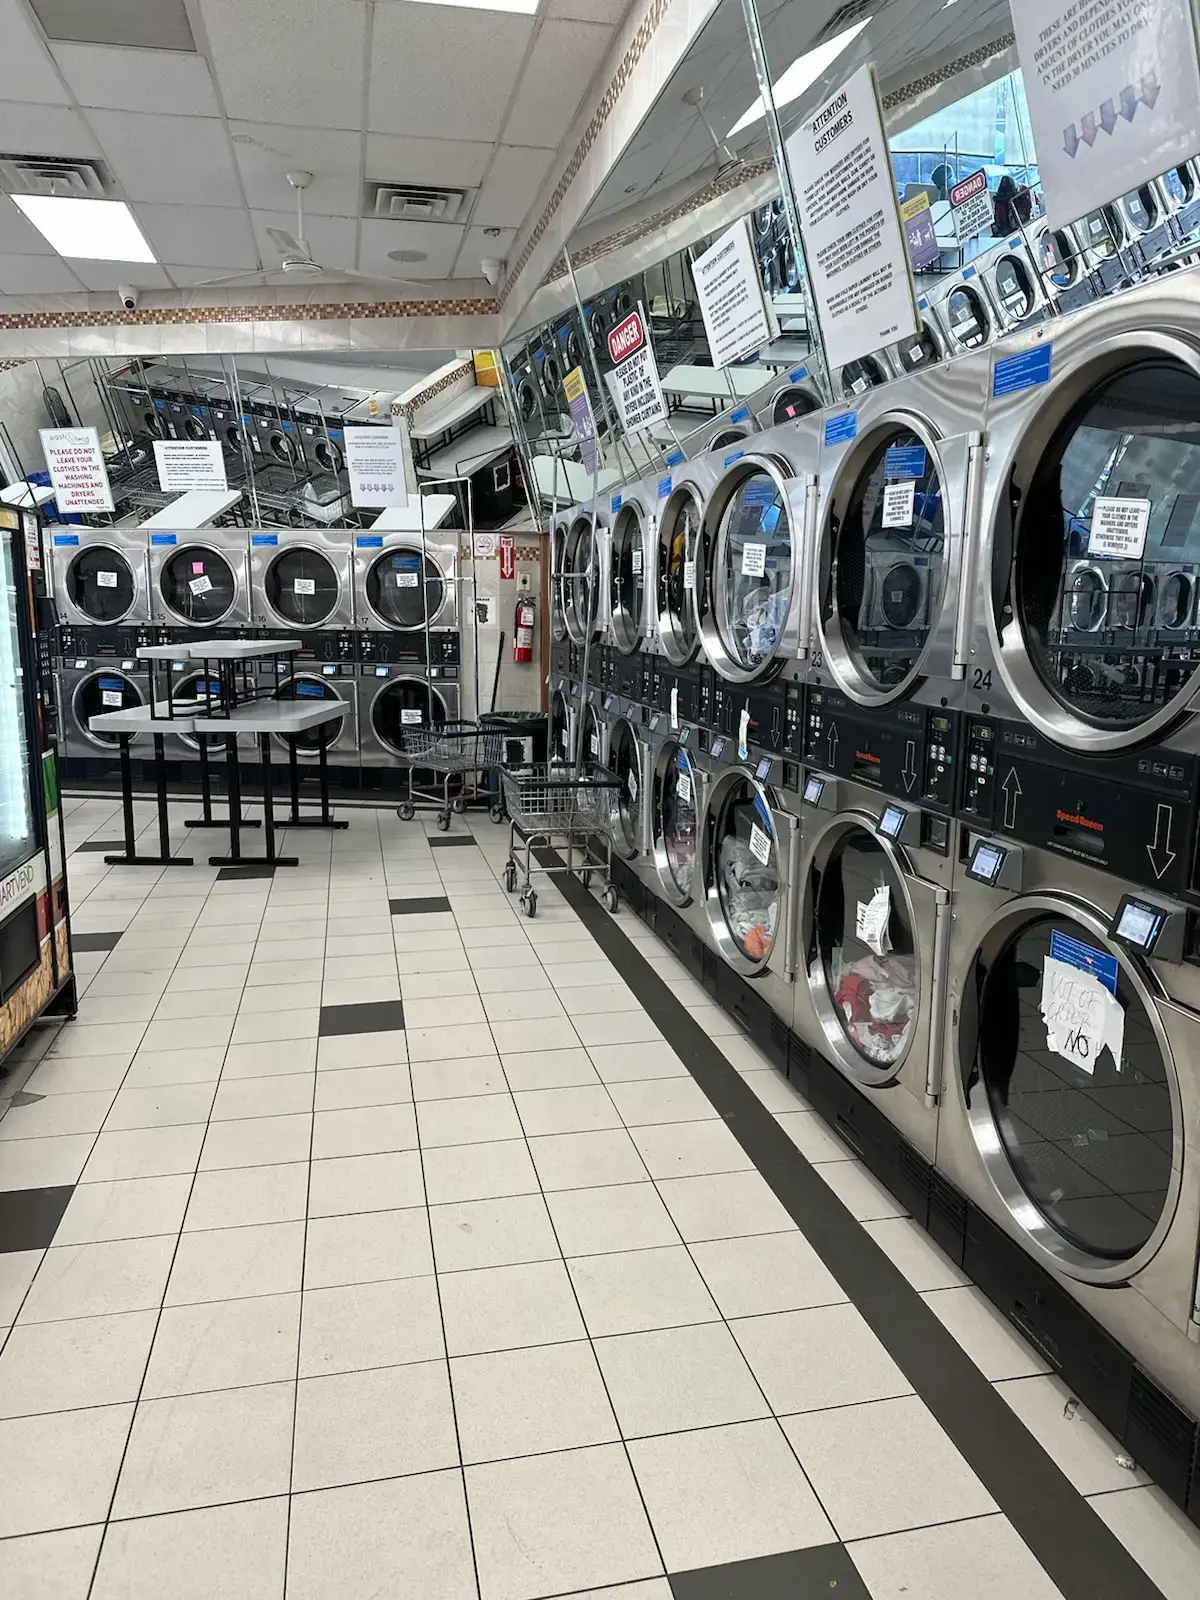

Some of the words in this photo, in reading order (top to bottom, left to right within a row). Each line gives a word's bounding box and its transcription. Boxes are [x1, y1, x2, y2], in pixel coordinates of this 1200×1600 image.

[1034, 35, 1062, 62] DRYERS
[1063, 21, 1078, 41] AND
[1036, 44, 1067, 76] AMOUNT
[1068, 36, 1078, 51] OF
[1079, 8, 1116, 41] CLOTHES
[1039, 18, 1061, 43] THESE
[1063, 6, 1080, 25] ARE
[1042, 73, 1050, 85] IN
[1052, 61, 1067, 80] THE
[1068, 42, 1092, 64] DRYER
[1094, 29, 1112, 48] YOU
[1112, 12, 1132, 32] MAY
[1052, 73, 1072, 94] NEED
[1072, 68, 1080, 79] 30
[1082, 38, 1116, 72] MINUTES
[1118, 30, 1129, 44] TO
[813, 92, 848, 133] ATTENTION
[815, 110, 852, 152] CUSTOMERS
[611, 321, 640, 356] DANGER
[812, 652, 822, 667] 23
[973, 668, 992, 690] 24
[0, 864, 34, 906] ARTVEND
[1050, 972, 1078, 1001] OUT
[1079, 990, 1101, 1009] OF
[1048, 1002, 1092, 1028] ORDER
[1064, 1027, 1091, 1058] NO
